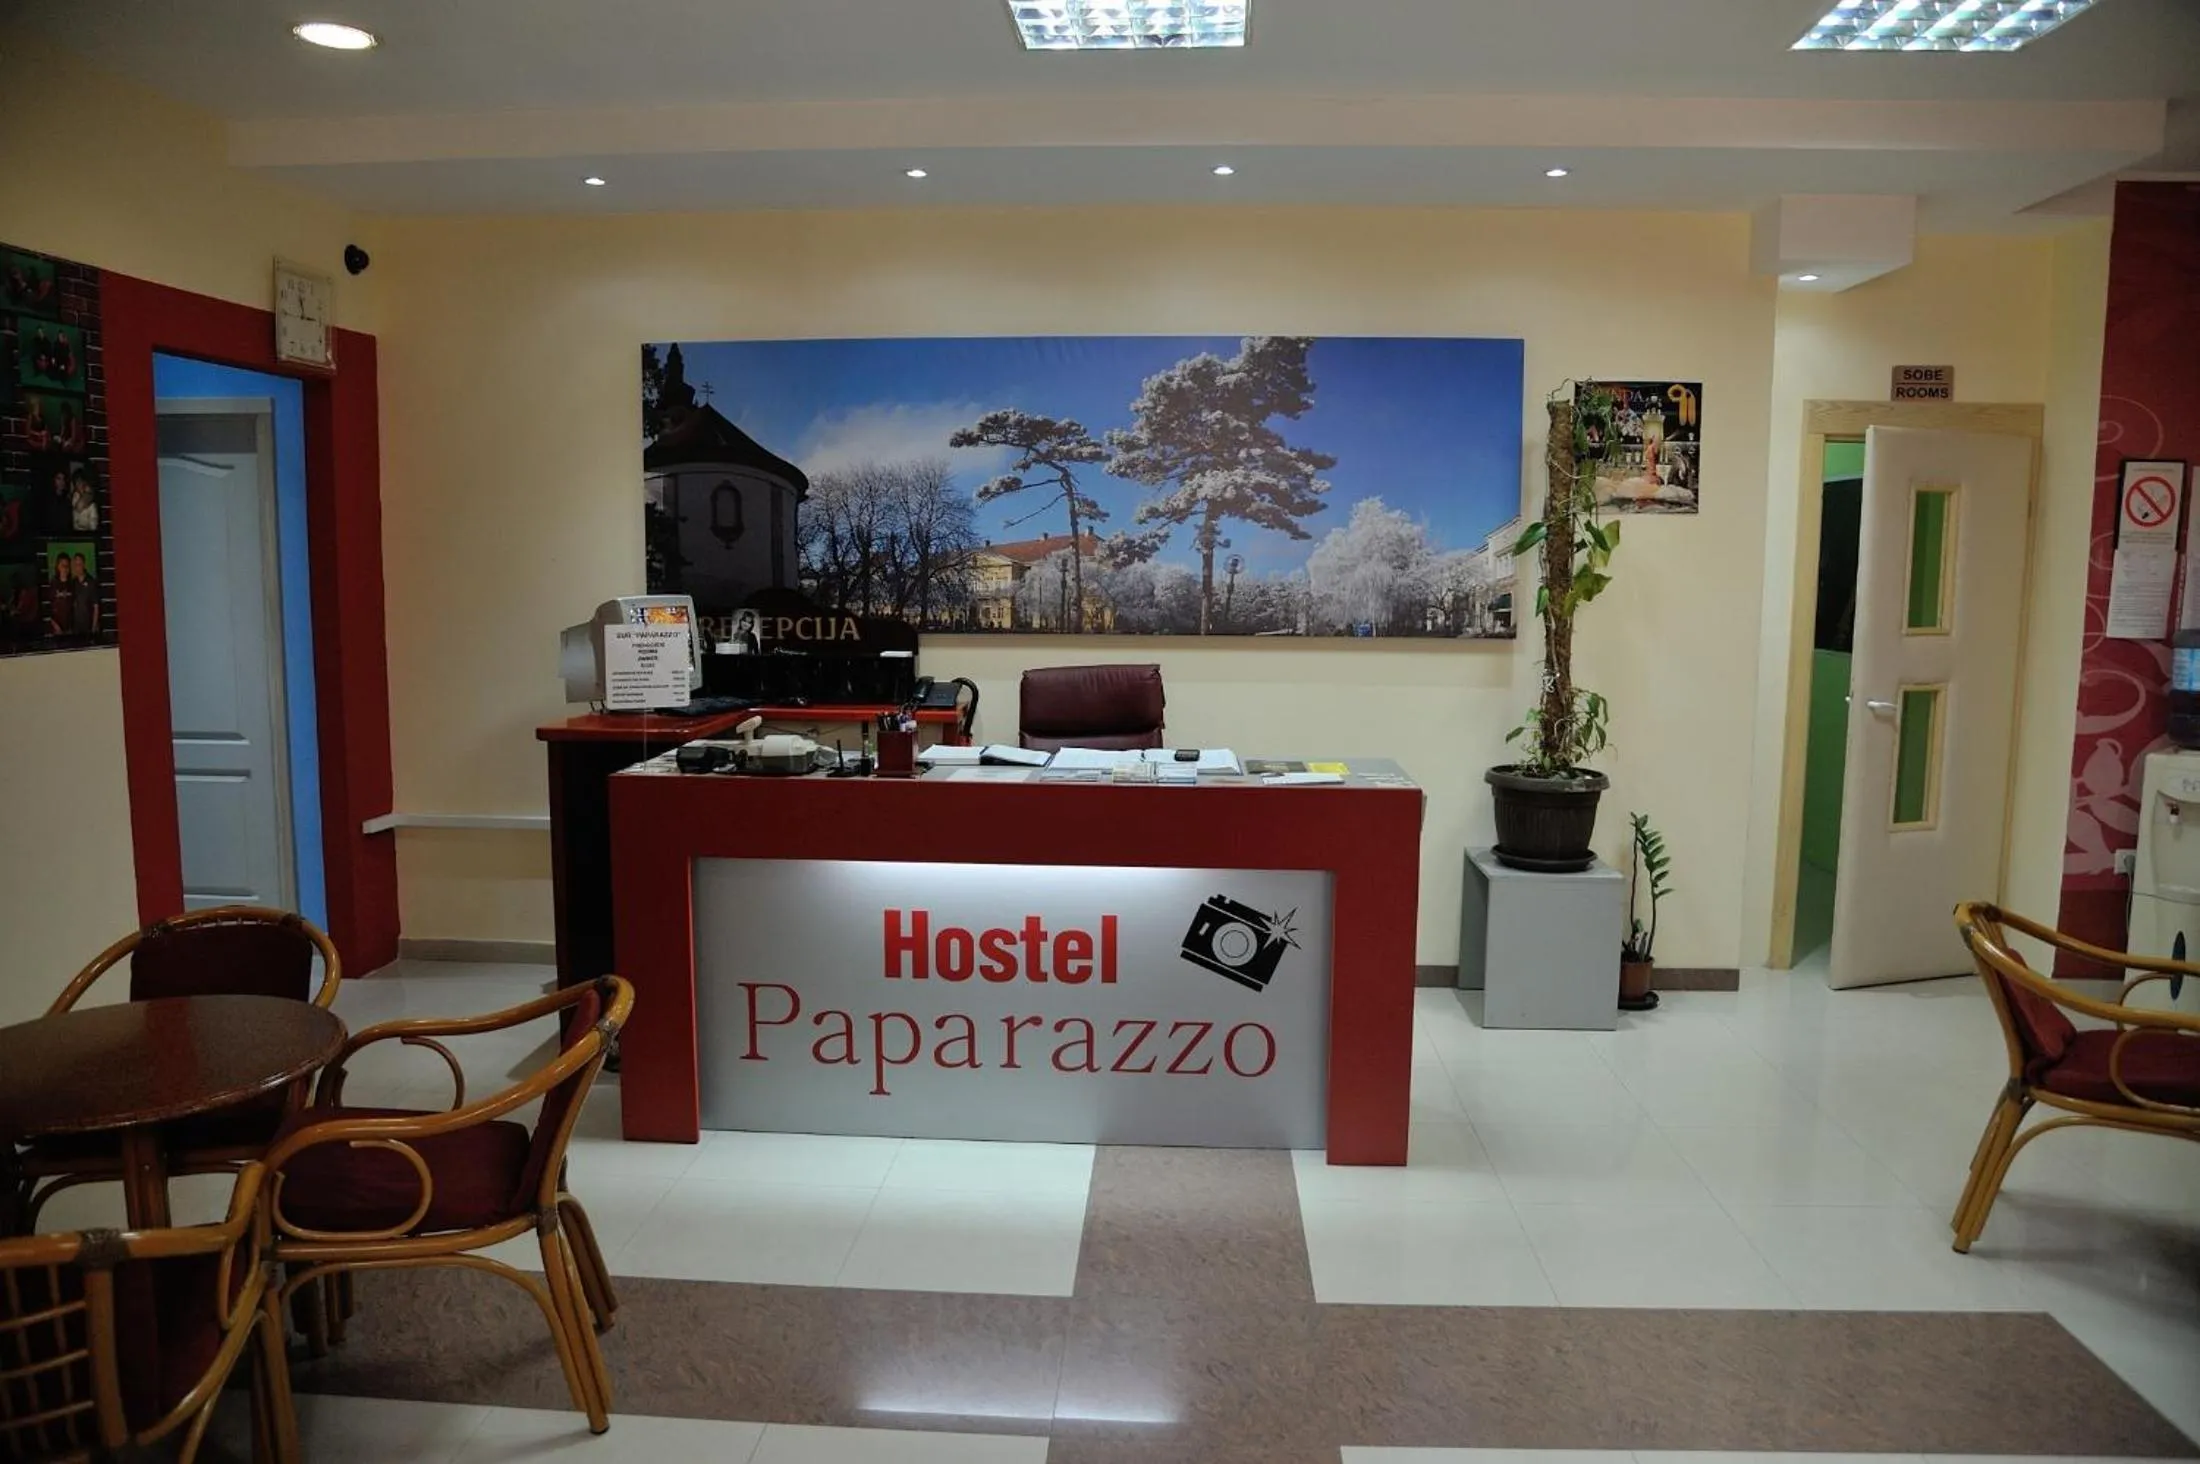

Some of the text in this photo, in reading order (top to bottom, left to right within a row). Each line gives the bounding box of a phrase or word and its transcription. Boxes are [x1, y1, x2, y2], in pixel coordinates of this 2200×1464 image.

[1903, 369, 1944, 381] SOBE
[1895, 387, 1949, 398] ROOMS
[699, 616, 861, 641] REEPCIJA
[884, 909, 1118, 984] Hostel
[736, 982, 1278, 1096] Paparazzo
